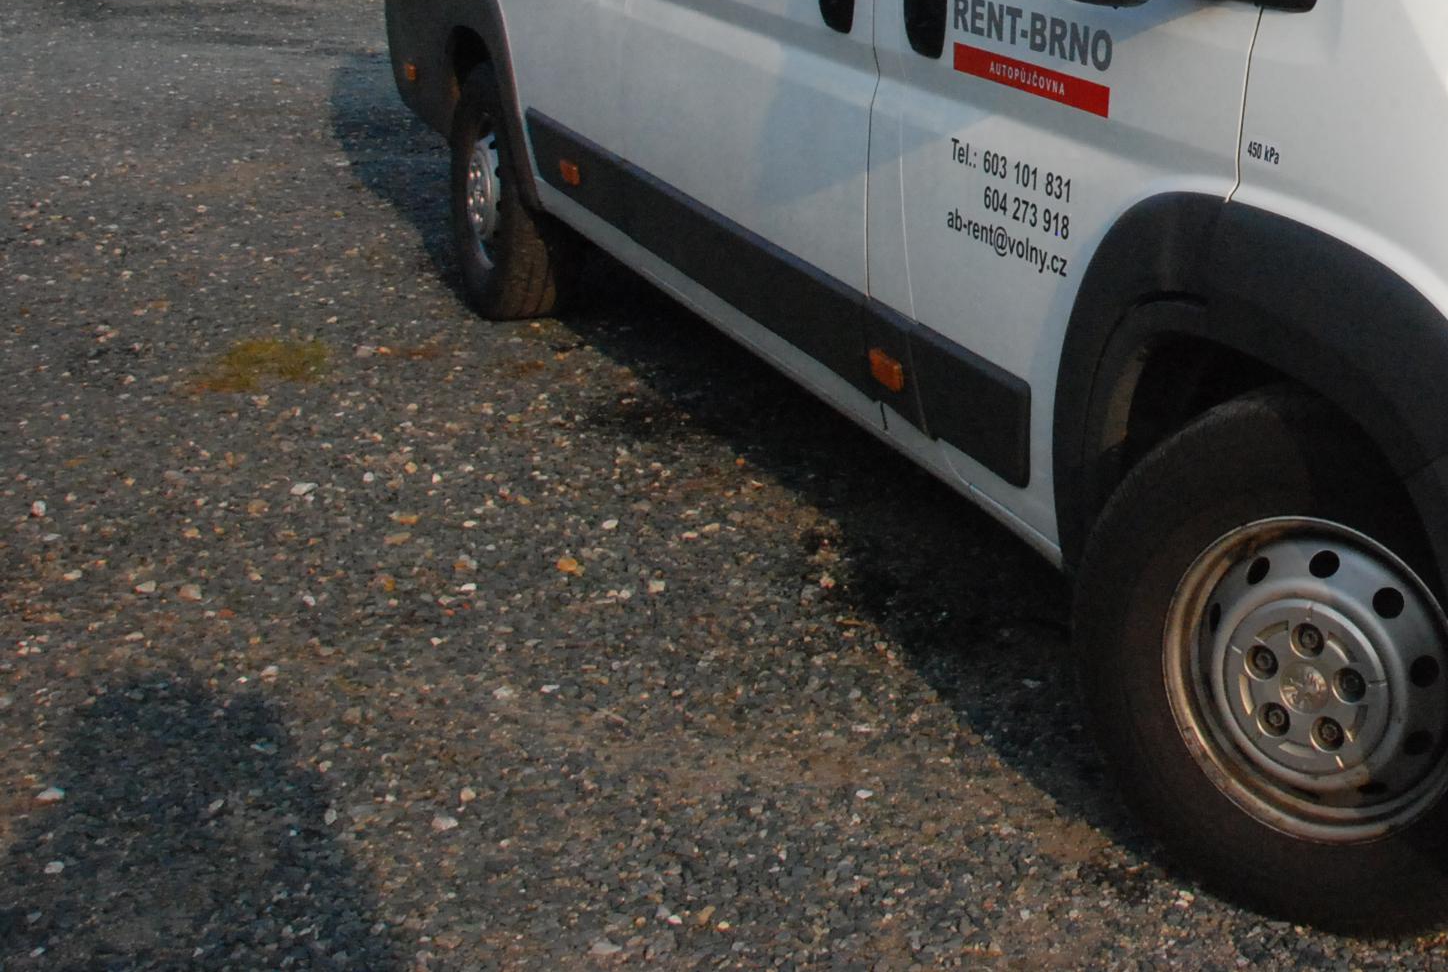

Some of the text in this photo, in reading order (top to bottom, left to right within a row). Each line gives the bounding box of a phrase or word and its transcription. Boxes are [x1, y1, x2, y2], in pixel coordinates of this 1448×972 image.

[989, 60, 1065, 96] AUTOPŮJČOVNA
[952, 138, 1071, 203] Tel.: 603 101 831
[1247, 141, 1279, 164] 450 kPa
[984, 186, 1070, 240] 604 273 918
[947, 208, 1067, 278] ab-rent@volny.cz
